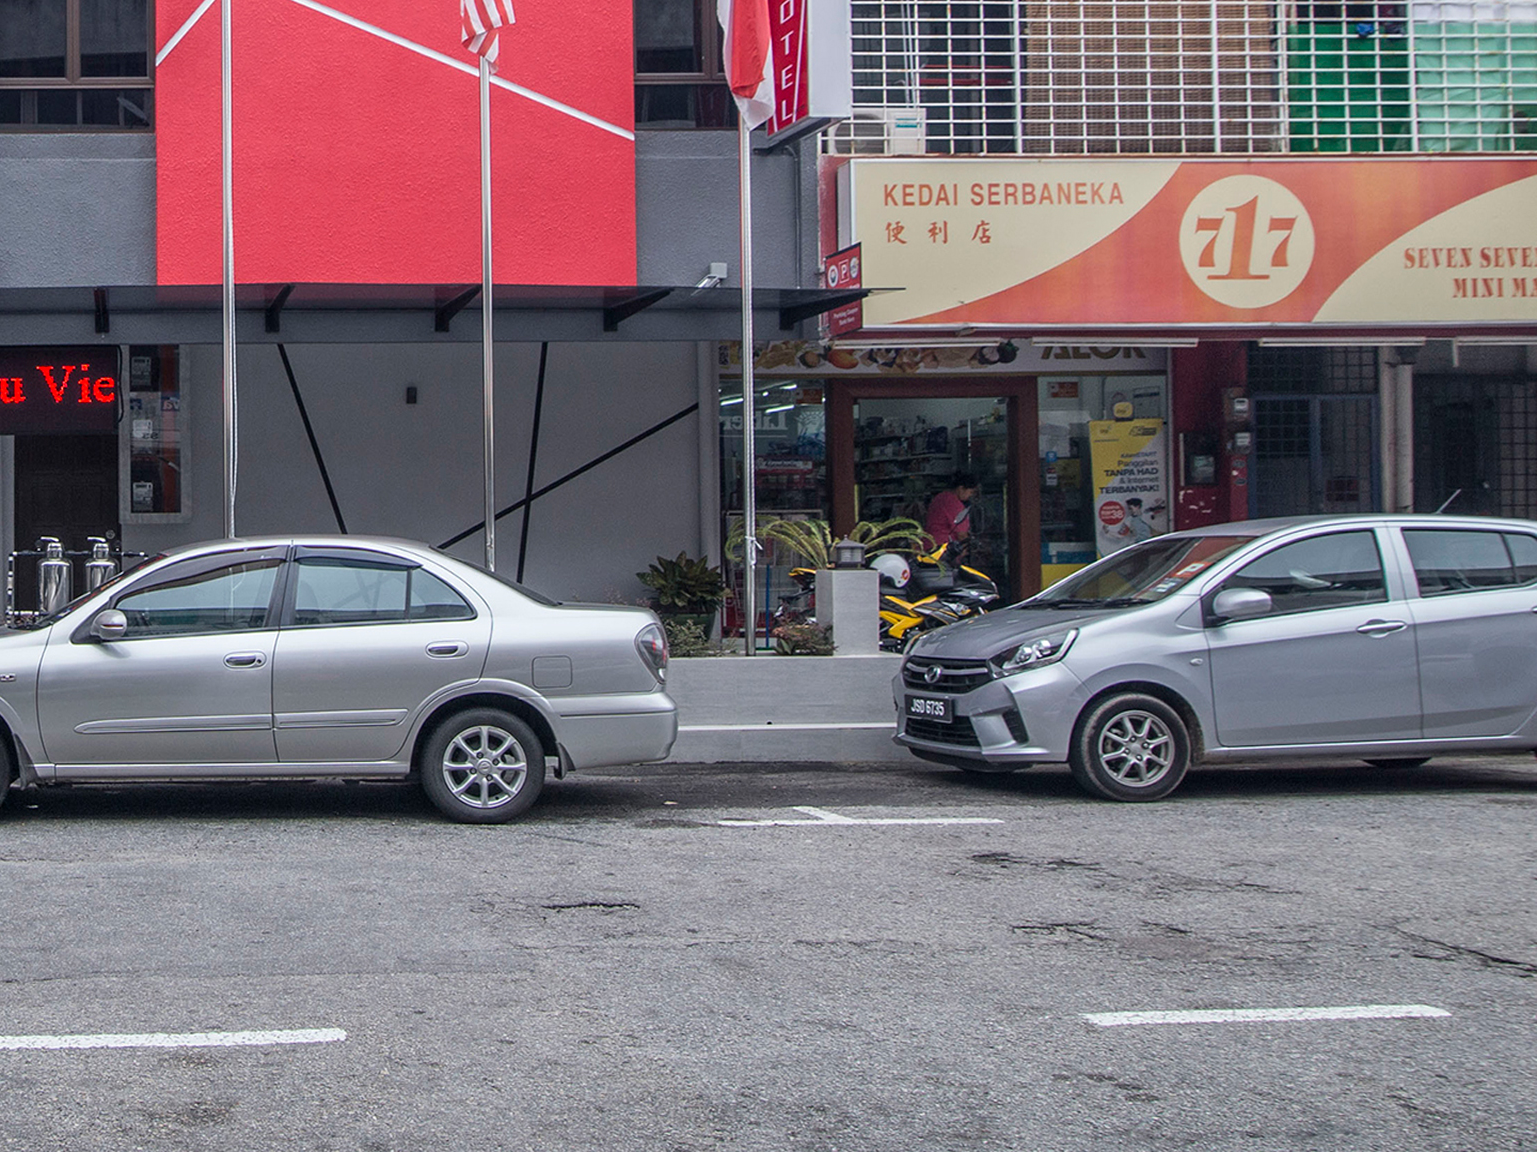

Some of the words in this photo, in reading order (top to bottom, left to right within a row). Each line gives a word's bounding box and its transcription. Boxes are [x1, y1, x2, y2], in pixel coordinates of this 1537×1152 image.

[884, 183, 959, 207] KEDAI
[970, 181, 1125, 206] SERBANEKA
[884, 219, 993, 245] 便利店
[1194, 194, 1299, 280] 717
[1403, 247, 1473, 269] SEVEN
[1479, 246, 1537, 269] SEVE
[1452, 277, 1505, 299] MINI
[36, 363, 116, 405] Vie
[1104, 469, 1136, 477] TANPA
[1137, 468, 1159, 476] HAD
